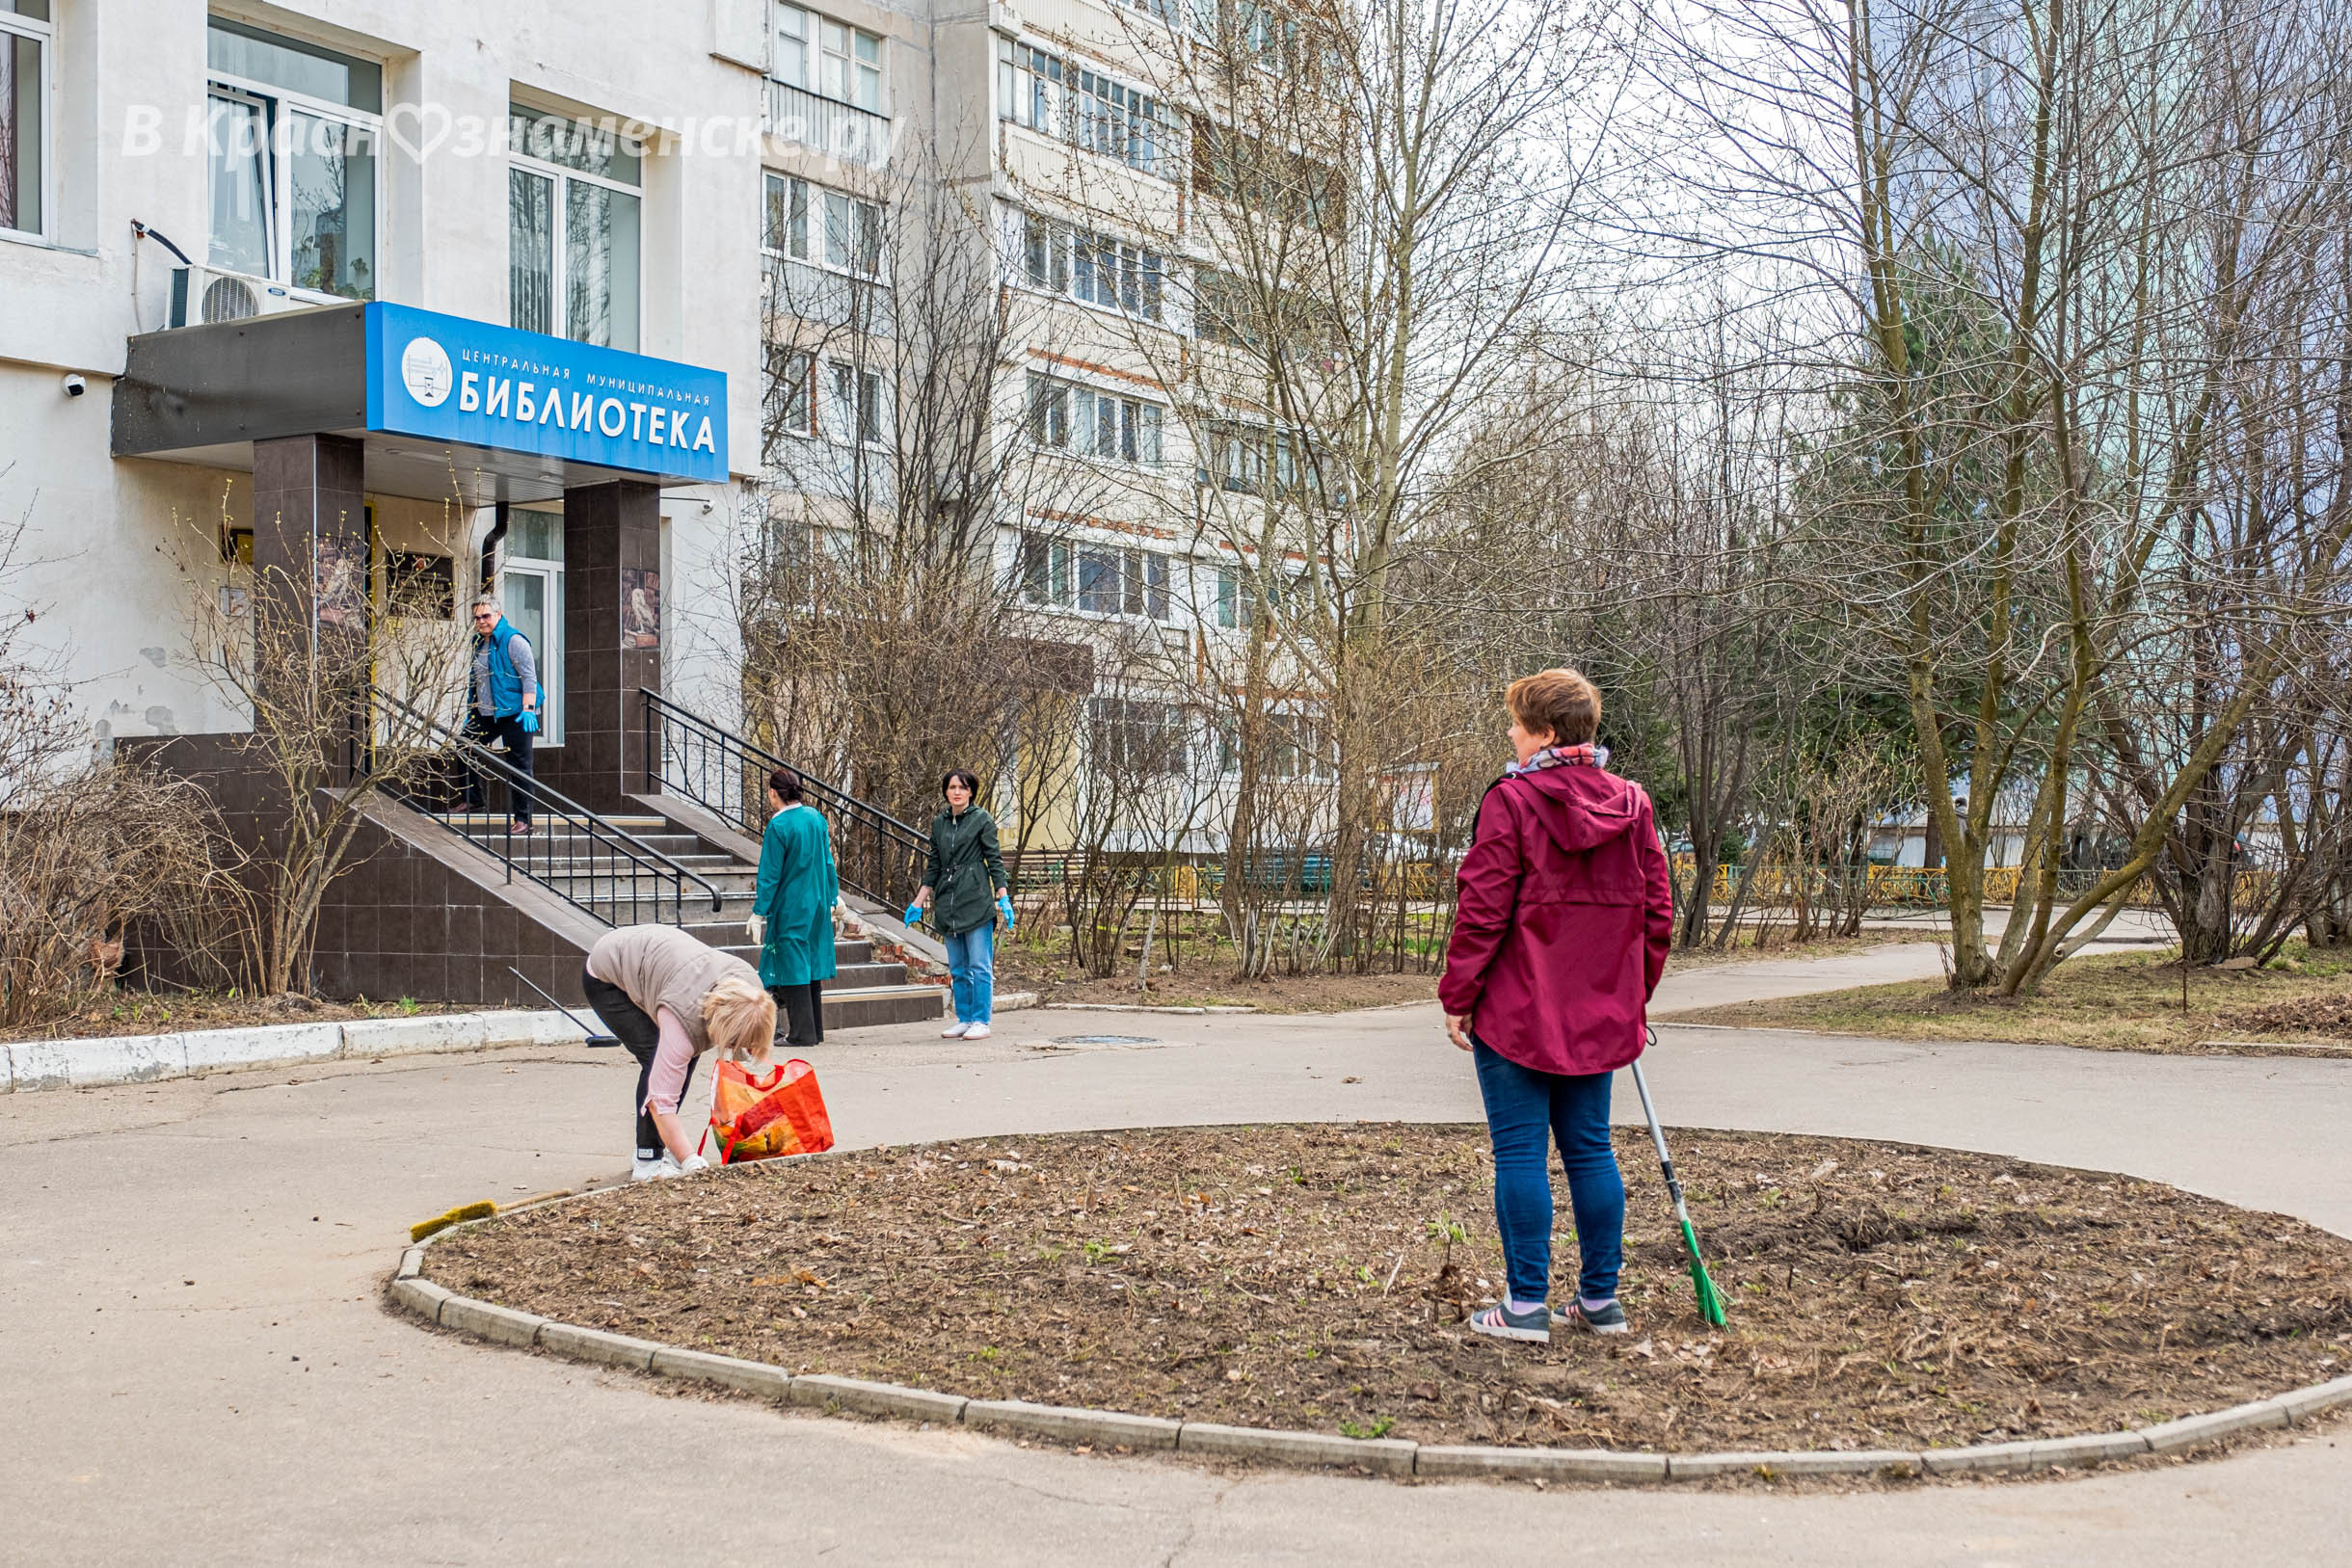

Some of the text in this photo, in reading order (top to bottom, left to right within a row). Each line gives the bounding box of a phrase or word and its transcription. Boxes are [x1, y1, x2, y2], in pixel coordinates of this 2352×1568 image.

[459, 370, 716, 454] БИБЛИОТЕКА
[463, 348, 710, 407] ЦЕНТРАЛЬНАЯ МУНИЦИПАЛЬНАЯ
